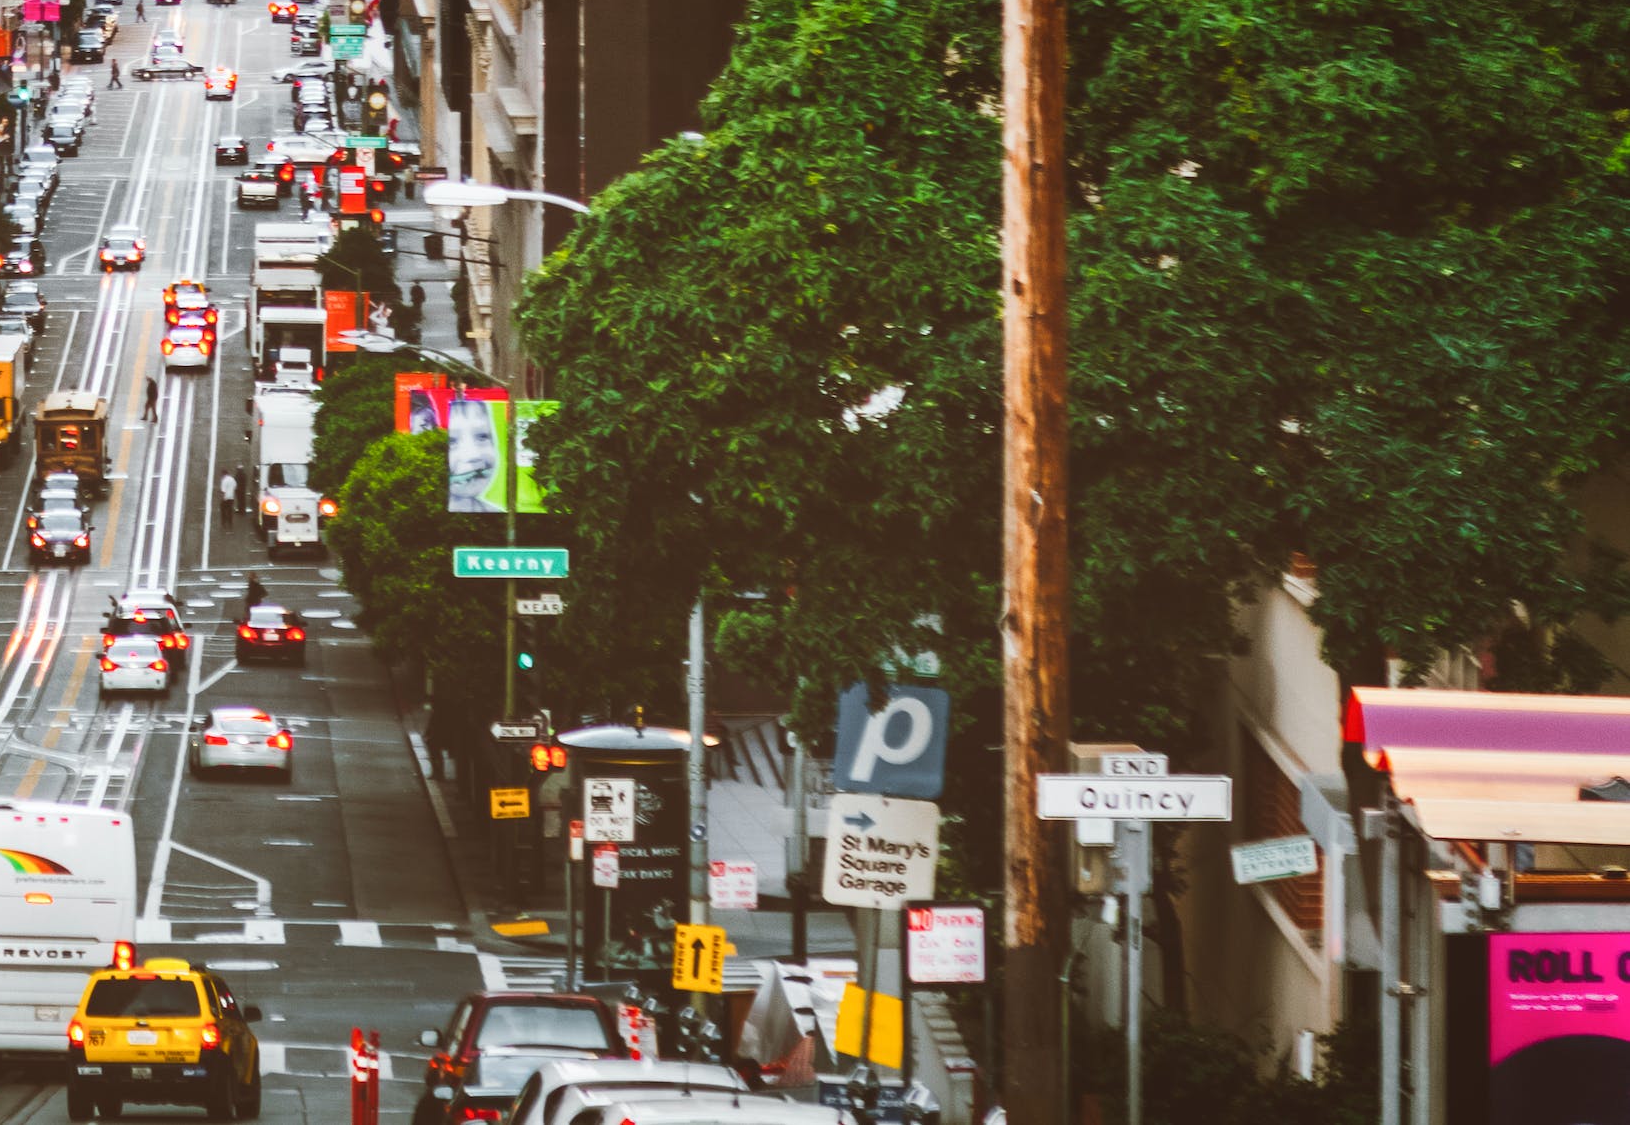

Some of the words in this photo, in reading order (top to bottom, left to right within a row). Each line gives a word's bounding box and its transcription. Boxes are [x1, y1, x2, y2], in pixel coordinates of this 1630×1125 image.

[466, 555, 554, 575] Kearny
[1111, 760, 1160, 775] END
[1079, 787, 1194, 817] Quincy
[590, 816, 603, 826] DO
[609, 816, 628, 825] NOT
[596, 829, 623, 840] PASS
[651, 847, 681, 856] MUSIC
[841, 834, 861, 851] St
[866, 836, 931, 860] Mary's
[839, 853, 907, 875] Square
[1242, 855, 1312, 874] ENTRANCE
[640, 869, 673, 879] DANCE
[838, 872, 907, 897] Garage
[909, 909, 932, 930] NO
[936, 915, 983, 928] PARKING
[1508, 949, 1604, 983] ROLL
[88, 1036, 105, 1047] 767
